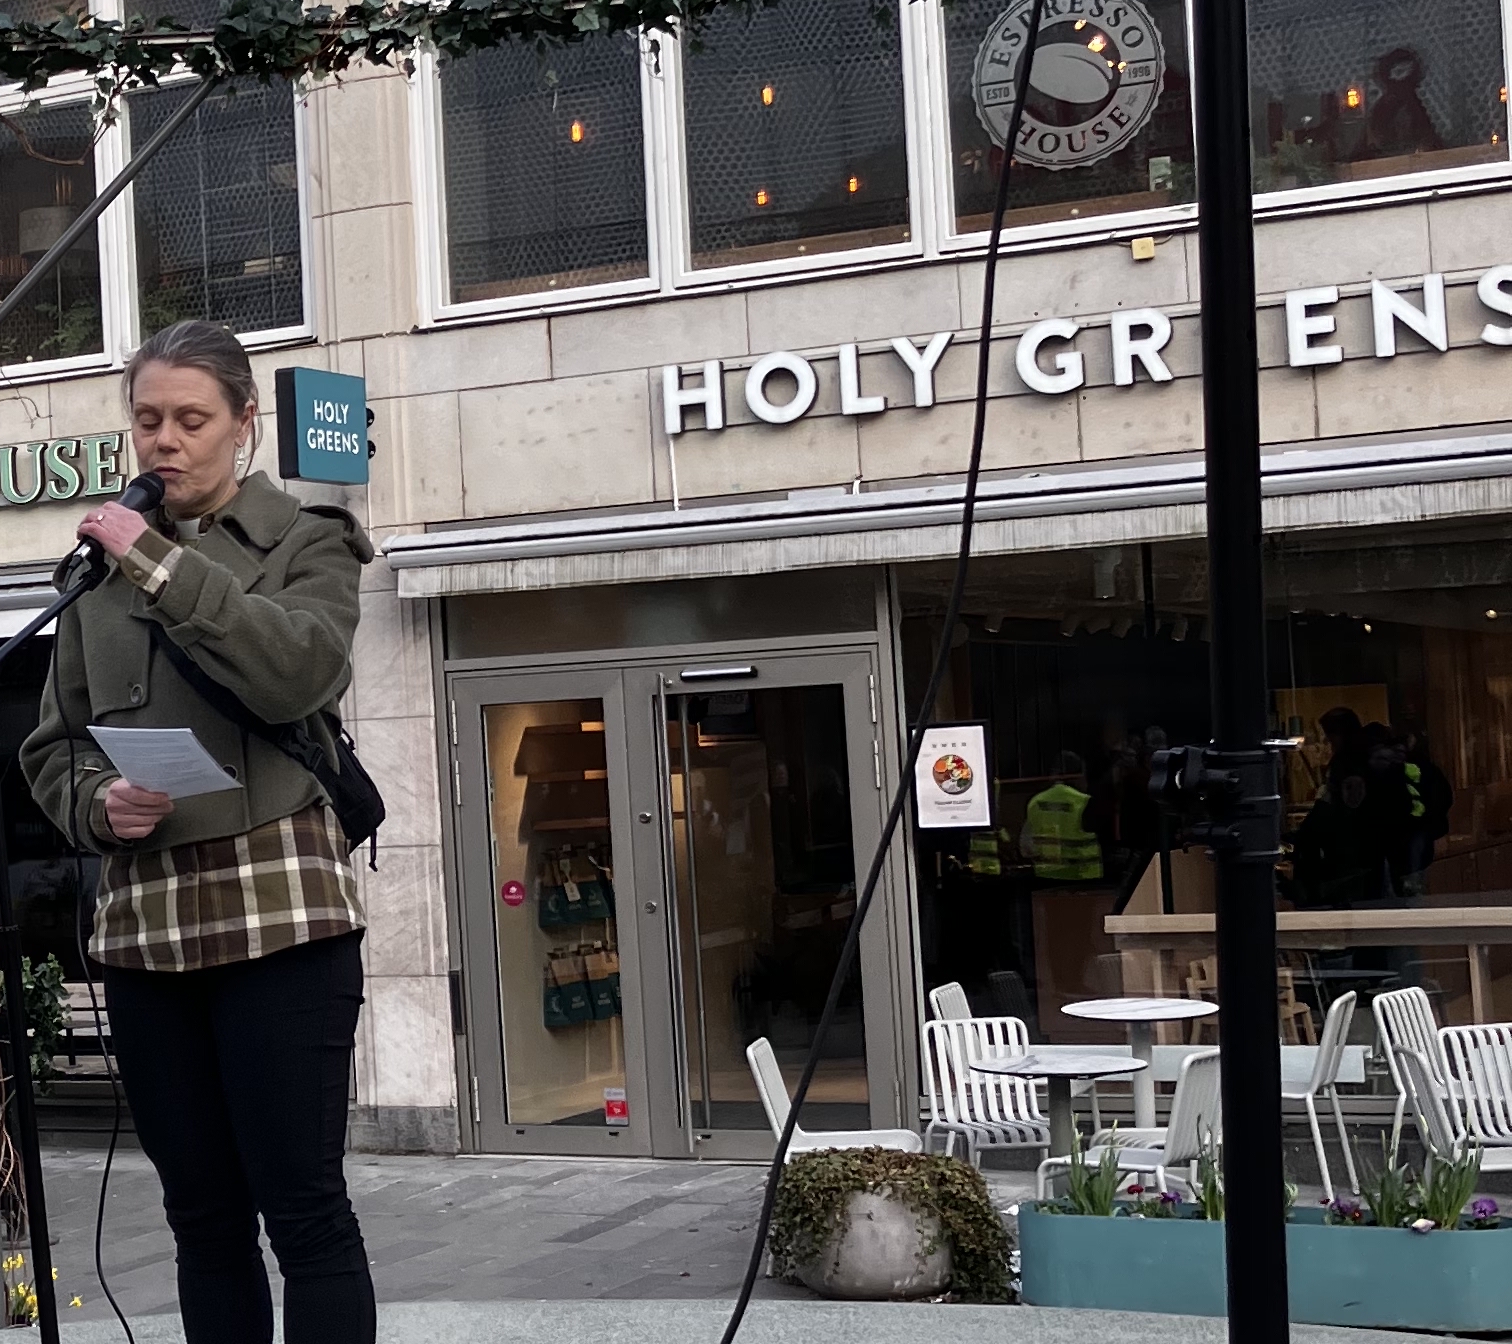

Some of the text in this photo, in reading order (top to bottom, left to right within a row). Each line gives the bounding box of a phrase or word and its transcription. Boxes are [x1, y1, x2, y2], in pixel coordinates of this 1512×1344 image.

[662, 264, 1512, 436] HOLY GRENS
[313, 399, 350, 425] HOLY
[306, 427, 360, 455] GREENS
